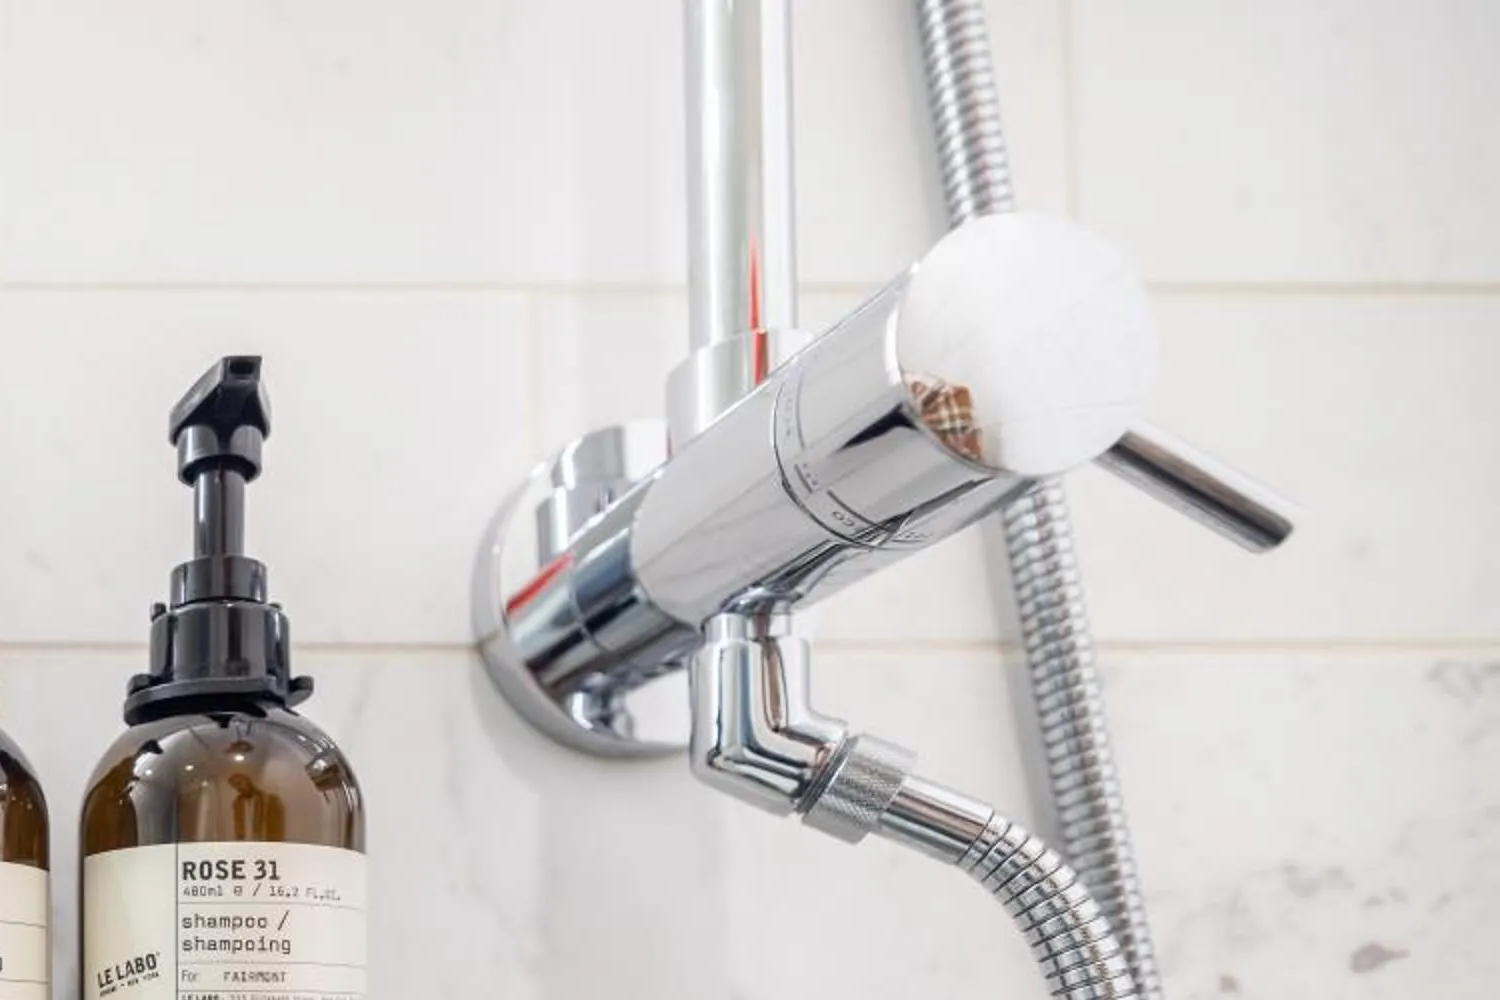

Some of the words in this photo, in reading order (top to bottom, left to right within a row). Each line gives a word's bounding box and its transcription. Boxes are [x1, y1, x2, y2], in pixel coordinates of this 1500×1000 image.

[183, 860, 246, 880] ROSE
[254, 861, 280, 880] 31
[184, 886, 223, 896] 480ml
[182, 914, 268, 931] shampoo
[183, 936, 291, 955] shampoing
[97, 967, 113, 988] LE
[223, 972, 286, 983] FAIRMONT
